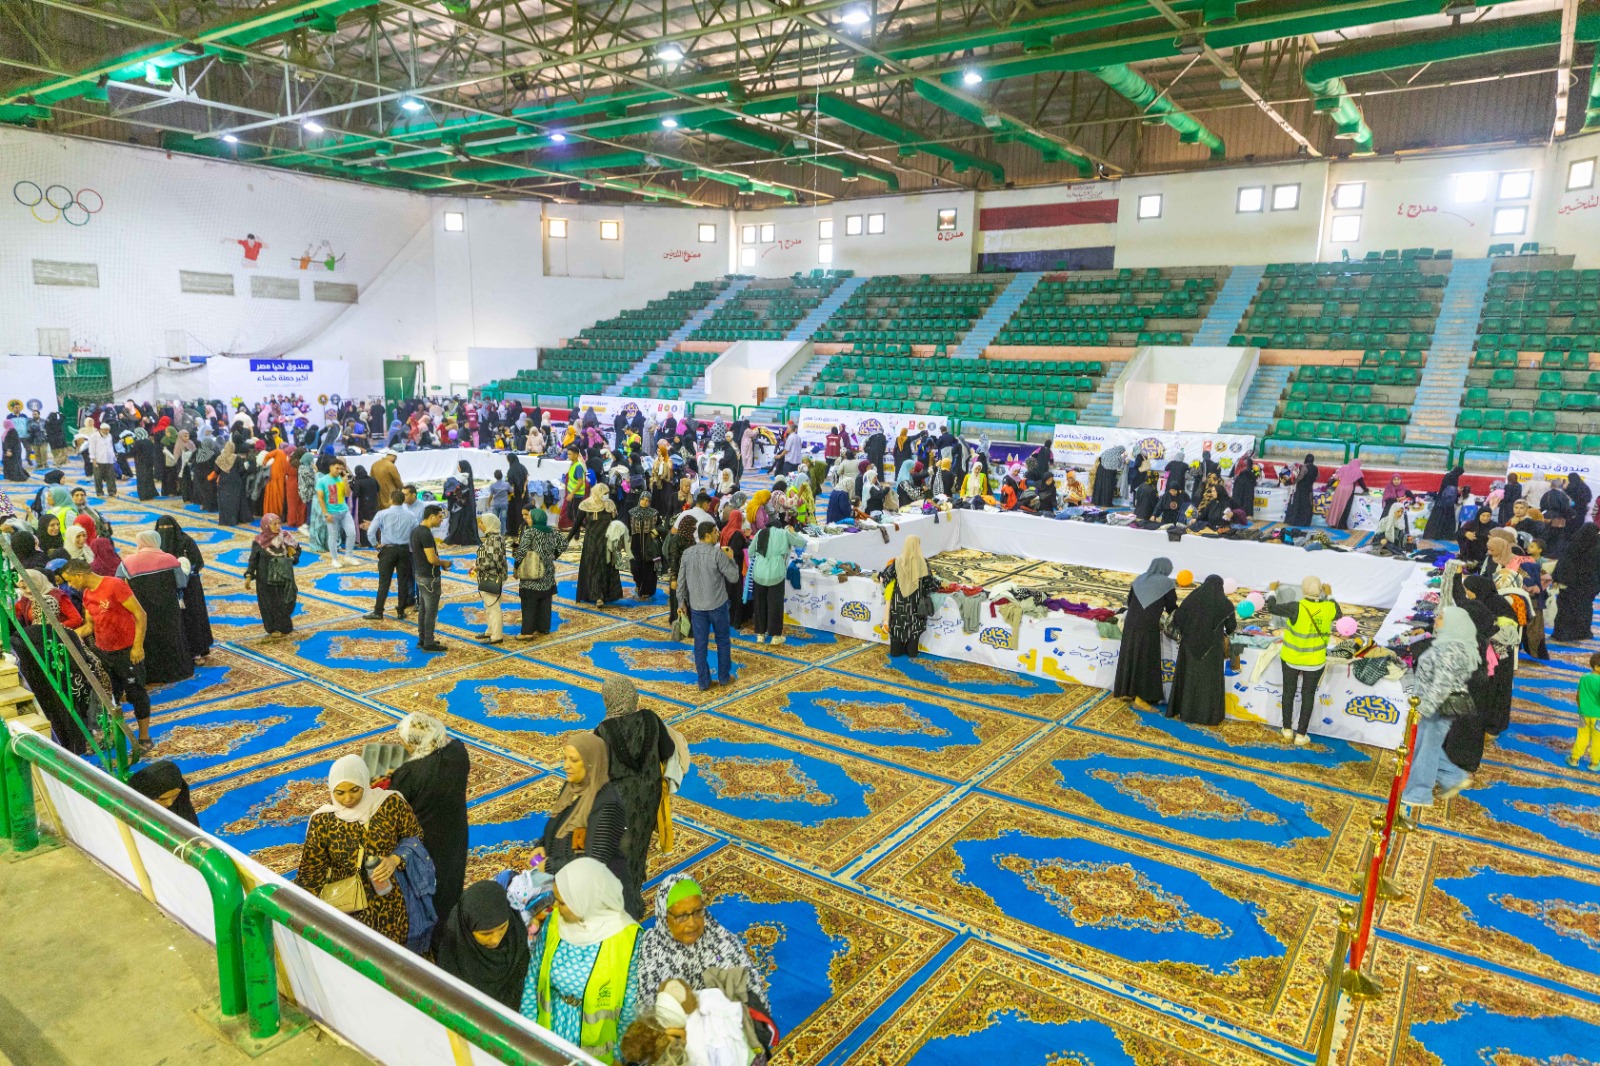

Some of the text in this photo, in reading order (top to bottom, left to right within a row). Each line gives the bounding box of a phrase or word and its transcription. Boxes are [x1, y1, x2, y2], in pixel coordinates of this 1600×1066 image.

[1397, 202, 1438, 218] مدرج ٤
[1558, 195, 1600, 214] لتدخين
[937, 231, 964, 241] مدرج ٥
[777, 238, 802, 250] مدرج ٦
[662, 248, 702, 263] ممنوع التدخين
[256, 362, 310, 372] صندوق تحيا مصر
[295, 373, 309, 382] أكبر
[1508, 462, 1590, 473] صندوق تحيا مصر
[841, 610, 871, 622] الفرحة
[1353, 696, 1395, 713] دكان
[1347, 703, 1400, 724] الفرحة
